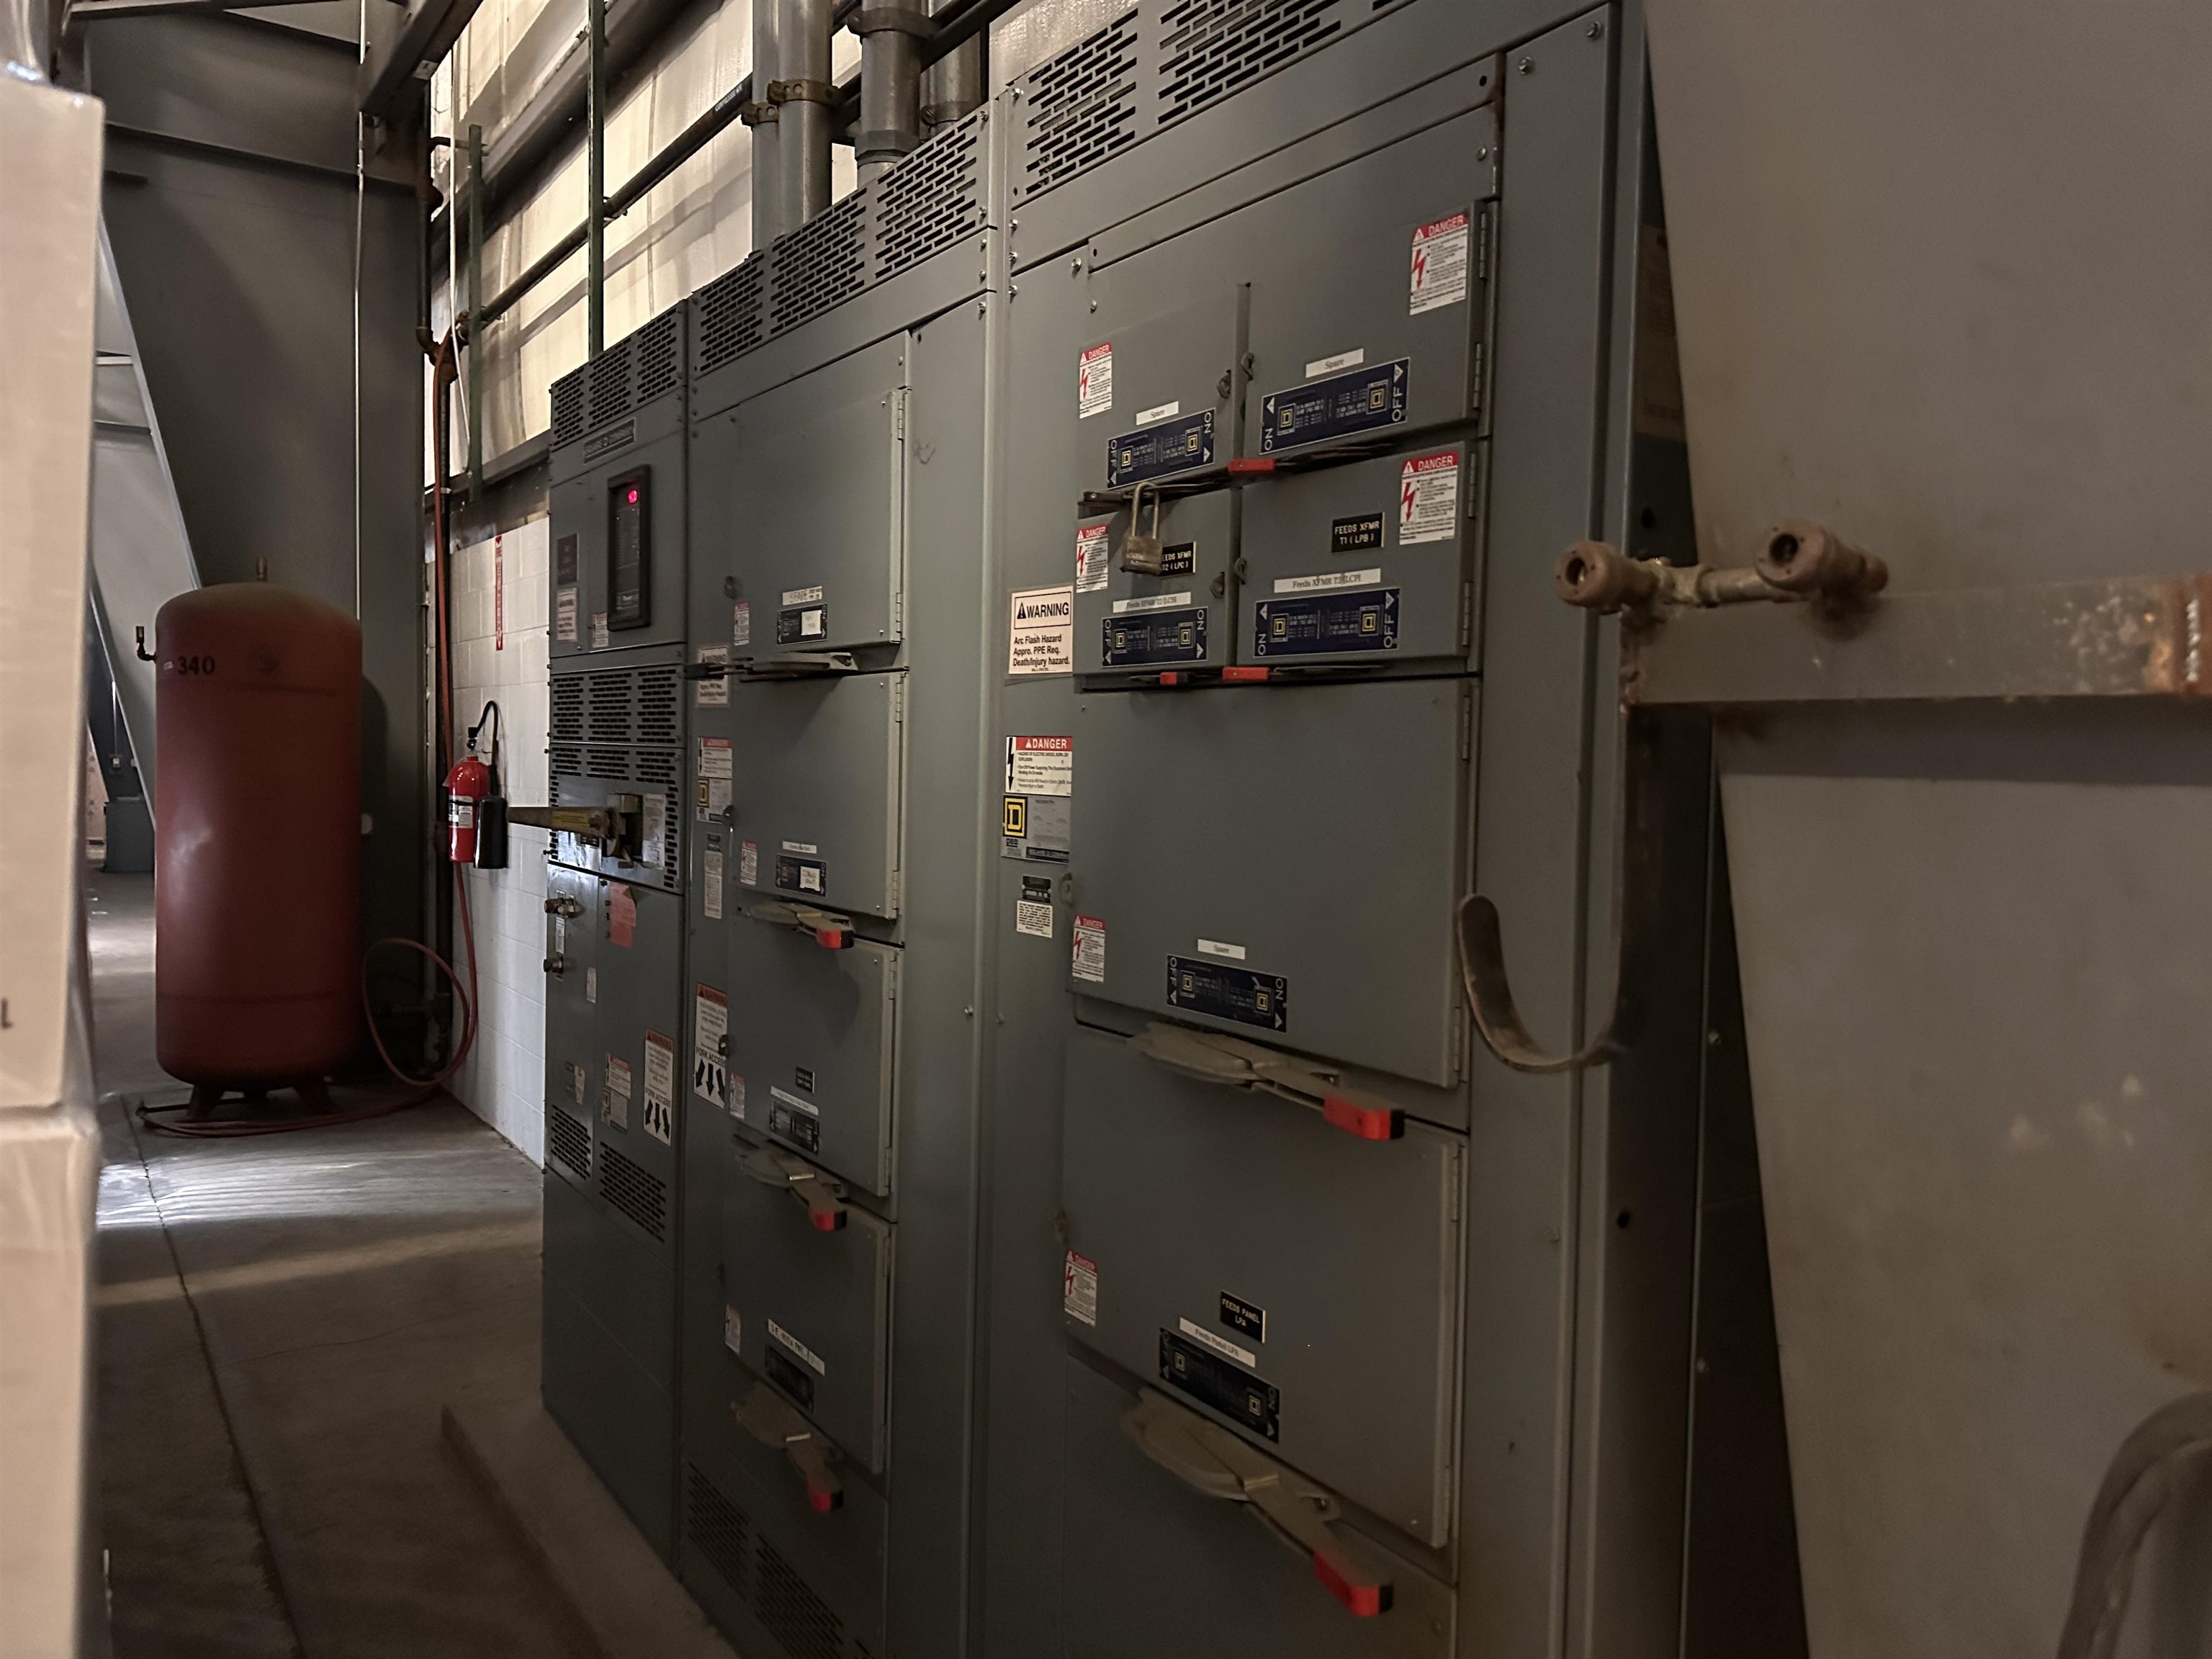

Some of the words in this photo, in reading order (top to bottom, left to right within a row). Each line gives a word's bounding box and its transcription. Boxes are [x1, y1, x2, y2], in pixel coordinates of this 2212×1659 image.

[1428, 215, 1464, 237] DANGER
[1089, 344, 1110, 359] DANGER
[1324, 359, 1344, 369] Spare
[1391, 387, 1403, 422] OFF
[1203, 412, 1212, 433] ON
[1264, 428, 1273, 451] ON
[1418, 455, 1454, 471] DANGER
[1085, 526, 1106, 538] DANGER
[1334, 524, 1357, 534] FEEDS
[1359, 521, 1380, 531] XFMR
[1177, 550, 1192, 559] XFMR
[1292, 580, 1310, 588] Feeds
[1027, 602, 1069, 619] WARNING
[1197, 610, 1204, 630] ON
[1383, 613, 1395, 648] OFF
[1025, 635, 1040, 644] Flash
[1041, 634, 1061, 643] Hazard
[1257, 633, 1266, 655] ON
[1013, 647, 1032, 656] Appro.
[1033, 646, 1046, 655] PPE
[1047, 646, 1060, 655] Req.
[178, 655, 215, 675] 340
[1048, 656, 1070, 665] hazard.
[1032, 738, 1067, 749] DANGER
[1275, 978, 1283, 1000] ON
[696, 1046, 708, 1058] FORK
[1222, 1298, 1240, 1313] FEEDS
[1235, 1316, 1246, 1327] LPA
